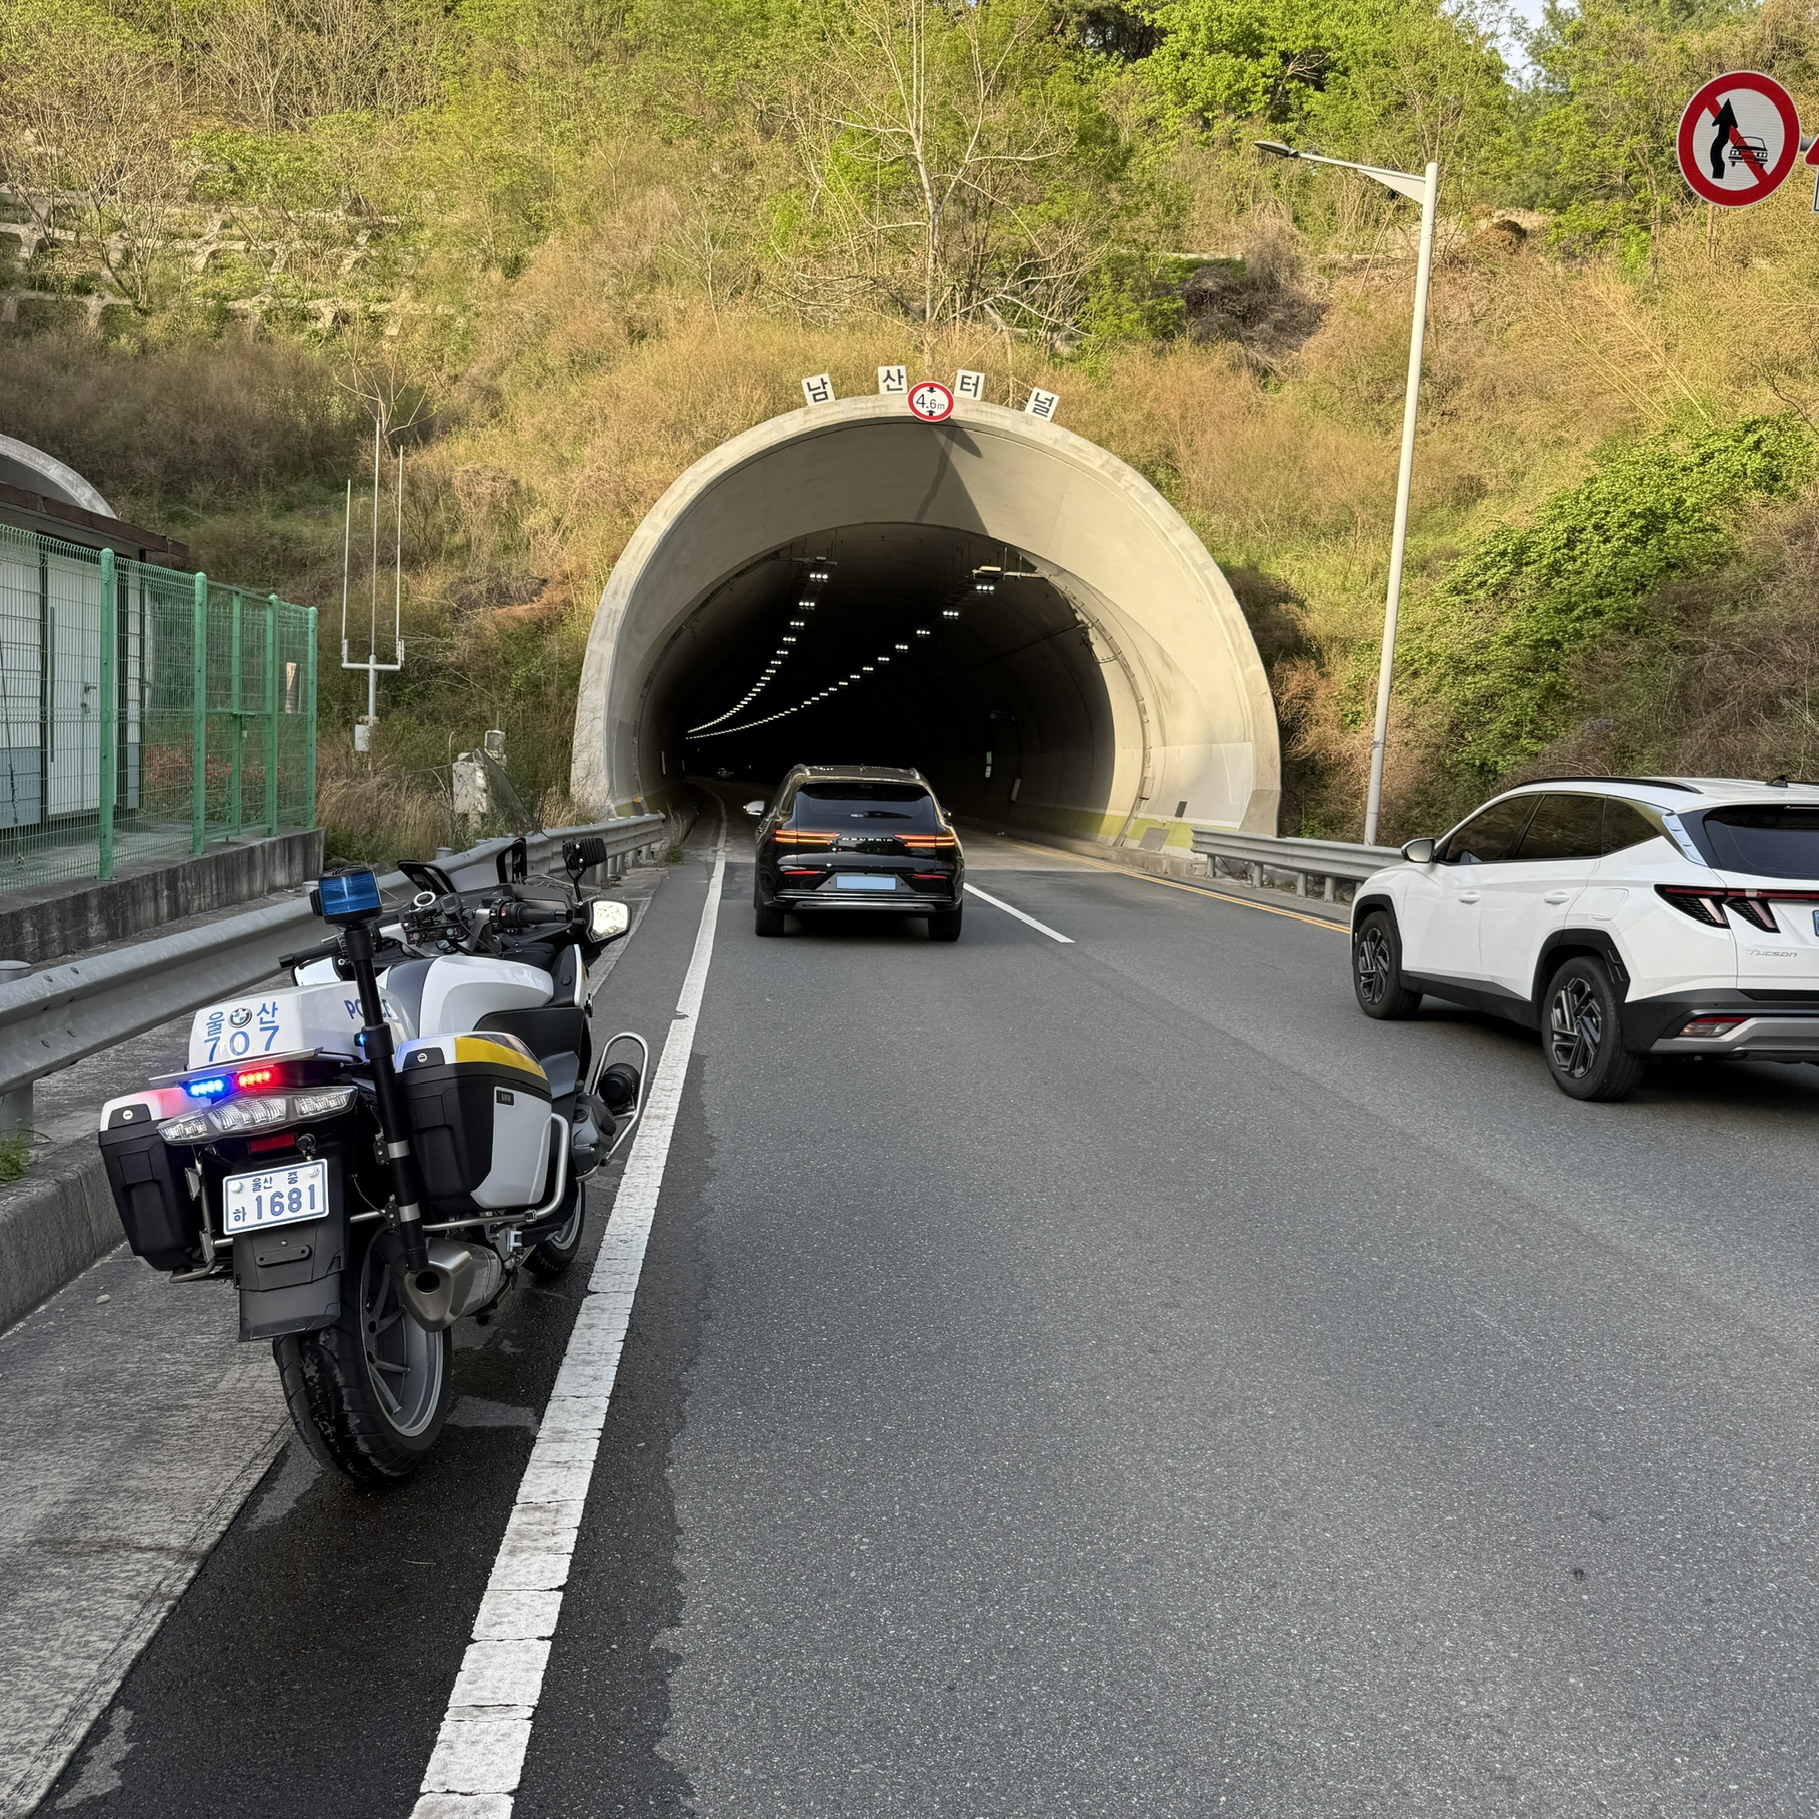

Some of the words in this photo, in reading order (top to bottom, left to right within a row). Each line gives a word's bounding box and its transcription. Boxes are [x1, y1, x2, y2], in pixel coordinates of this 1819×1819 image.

[916, 394, 945, 410] 4.6m
[203, 1024, 280, 1062] 707
[255, 1184, 315, 1220] 1681
